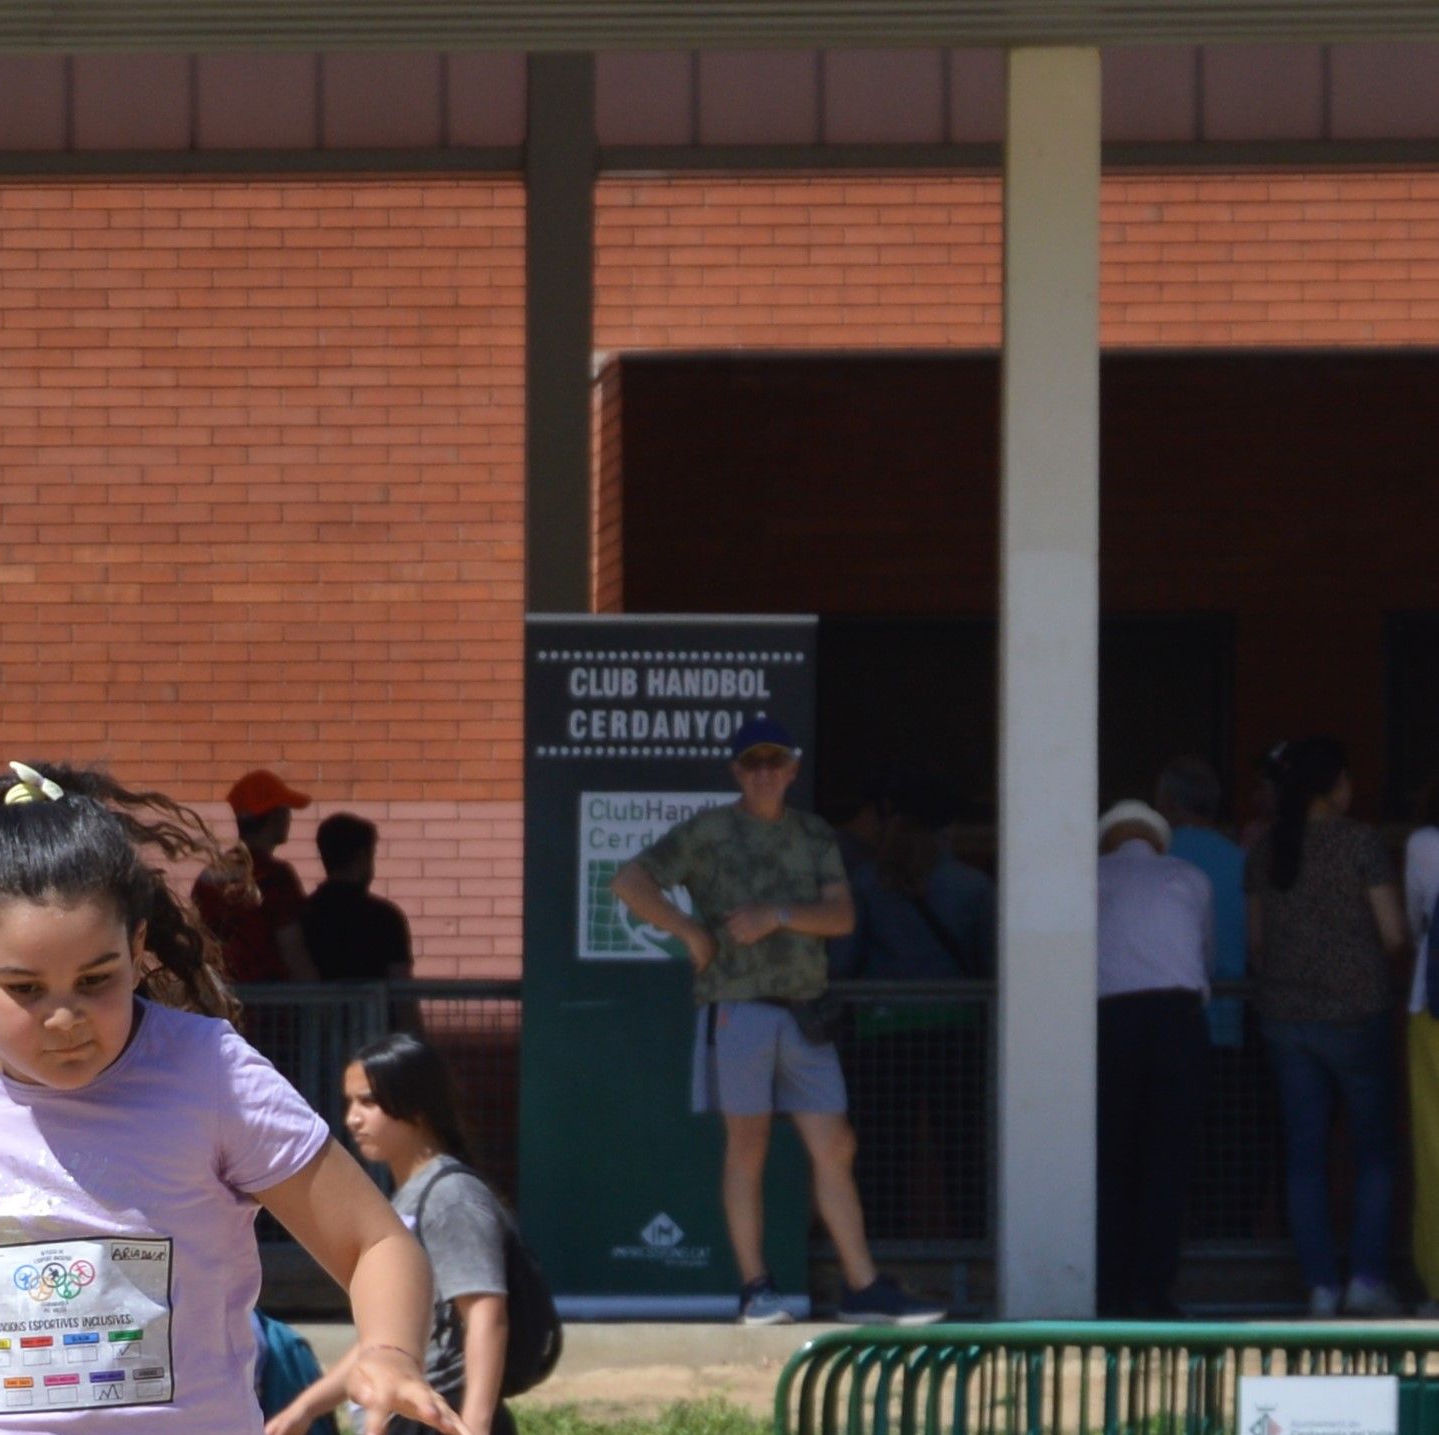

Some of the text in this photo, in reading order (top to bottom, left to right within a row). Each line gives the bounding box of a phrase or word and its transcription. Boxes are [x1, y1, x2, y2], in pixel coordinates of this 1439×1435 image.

[569, 667, 771, 698] CLUB HANDBOL
[569, 709, 767, 740] CERDANYOL
